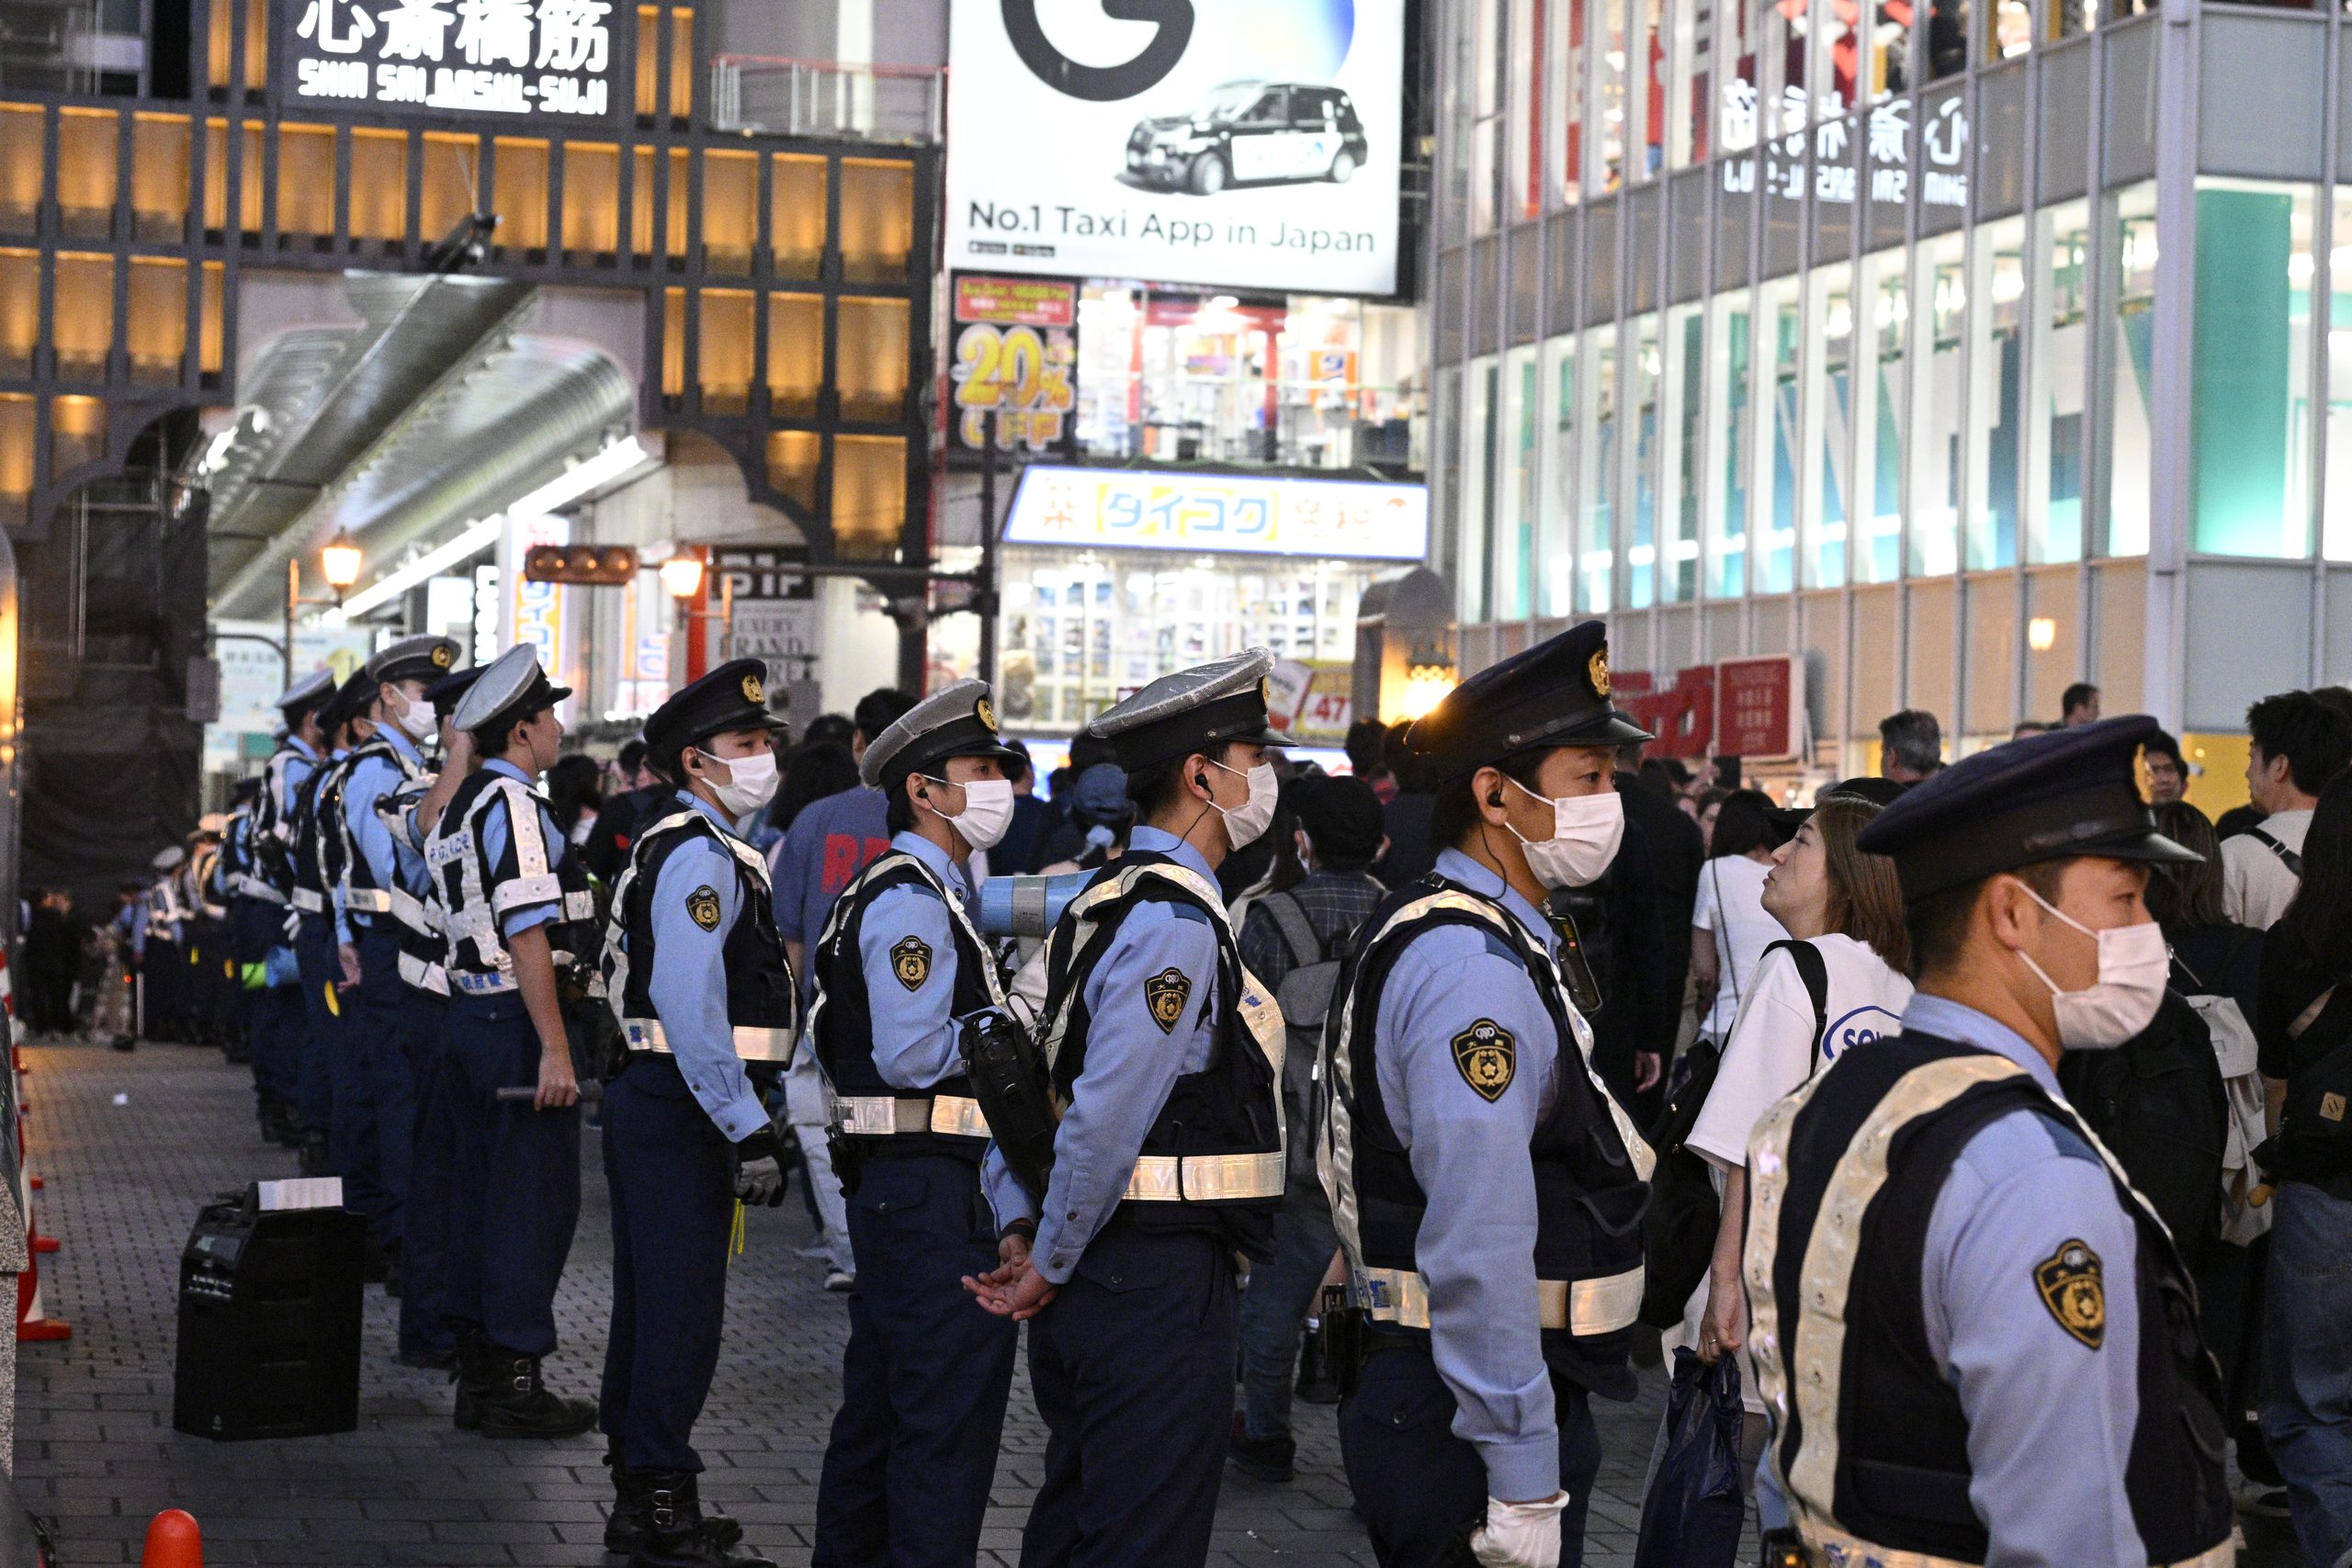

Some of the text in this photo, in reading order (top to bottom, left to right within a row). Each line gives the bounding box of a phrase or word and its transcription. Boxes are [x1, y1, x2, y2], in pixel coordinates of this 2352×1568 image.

[299, 58, 368, 99] SHIN
[968, 201, 1375, 254] No.1 Taxi App in Japan
[958, 327, 1074, 410] 20%
